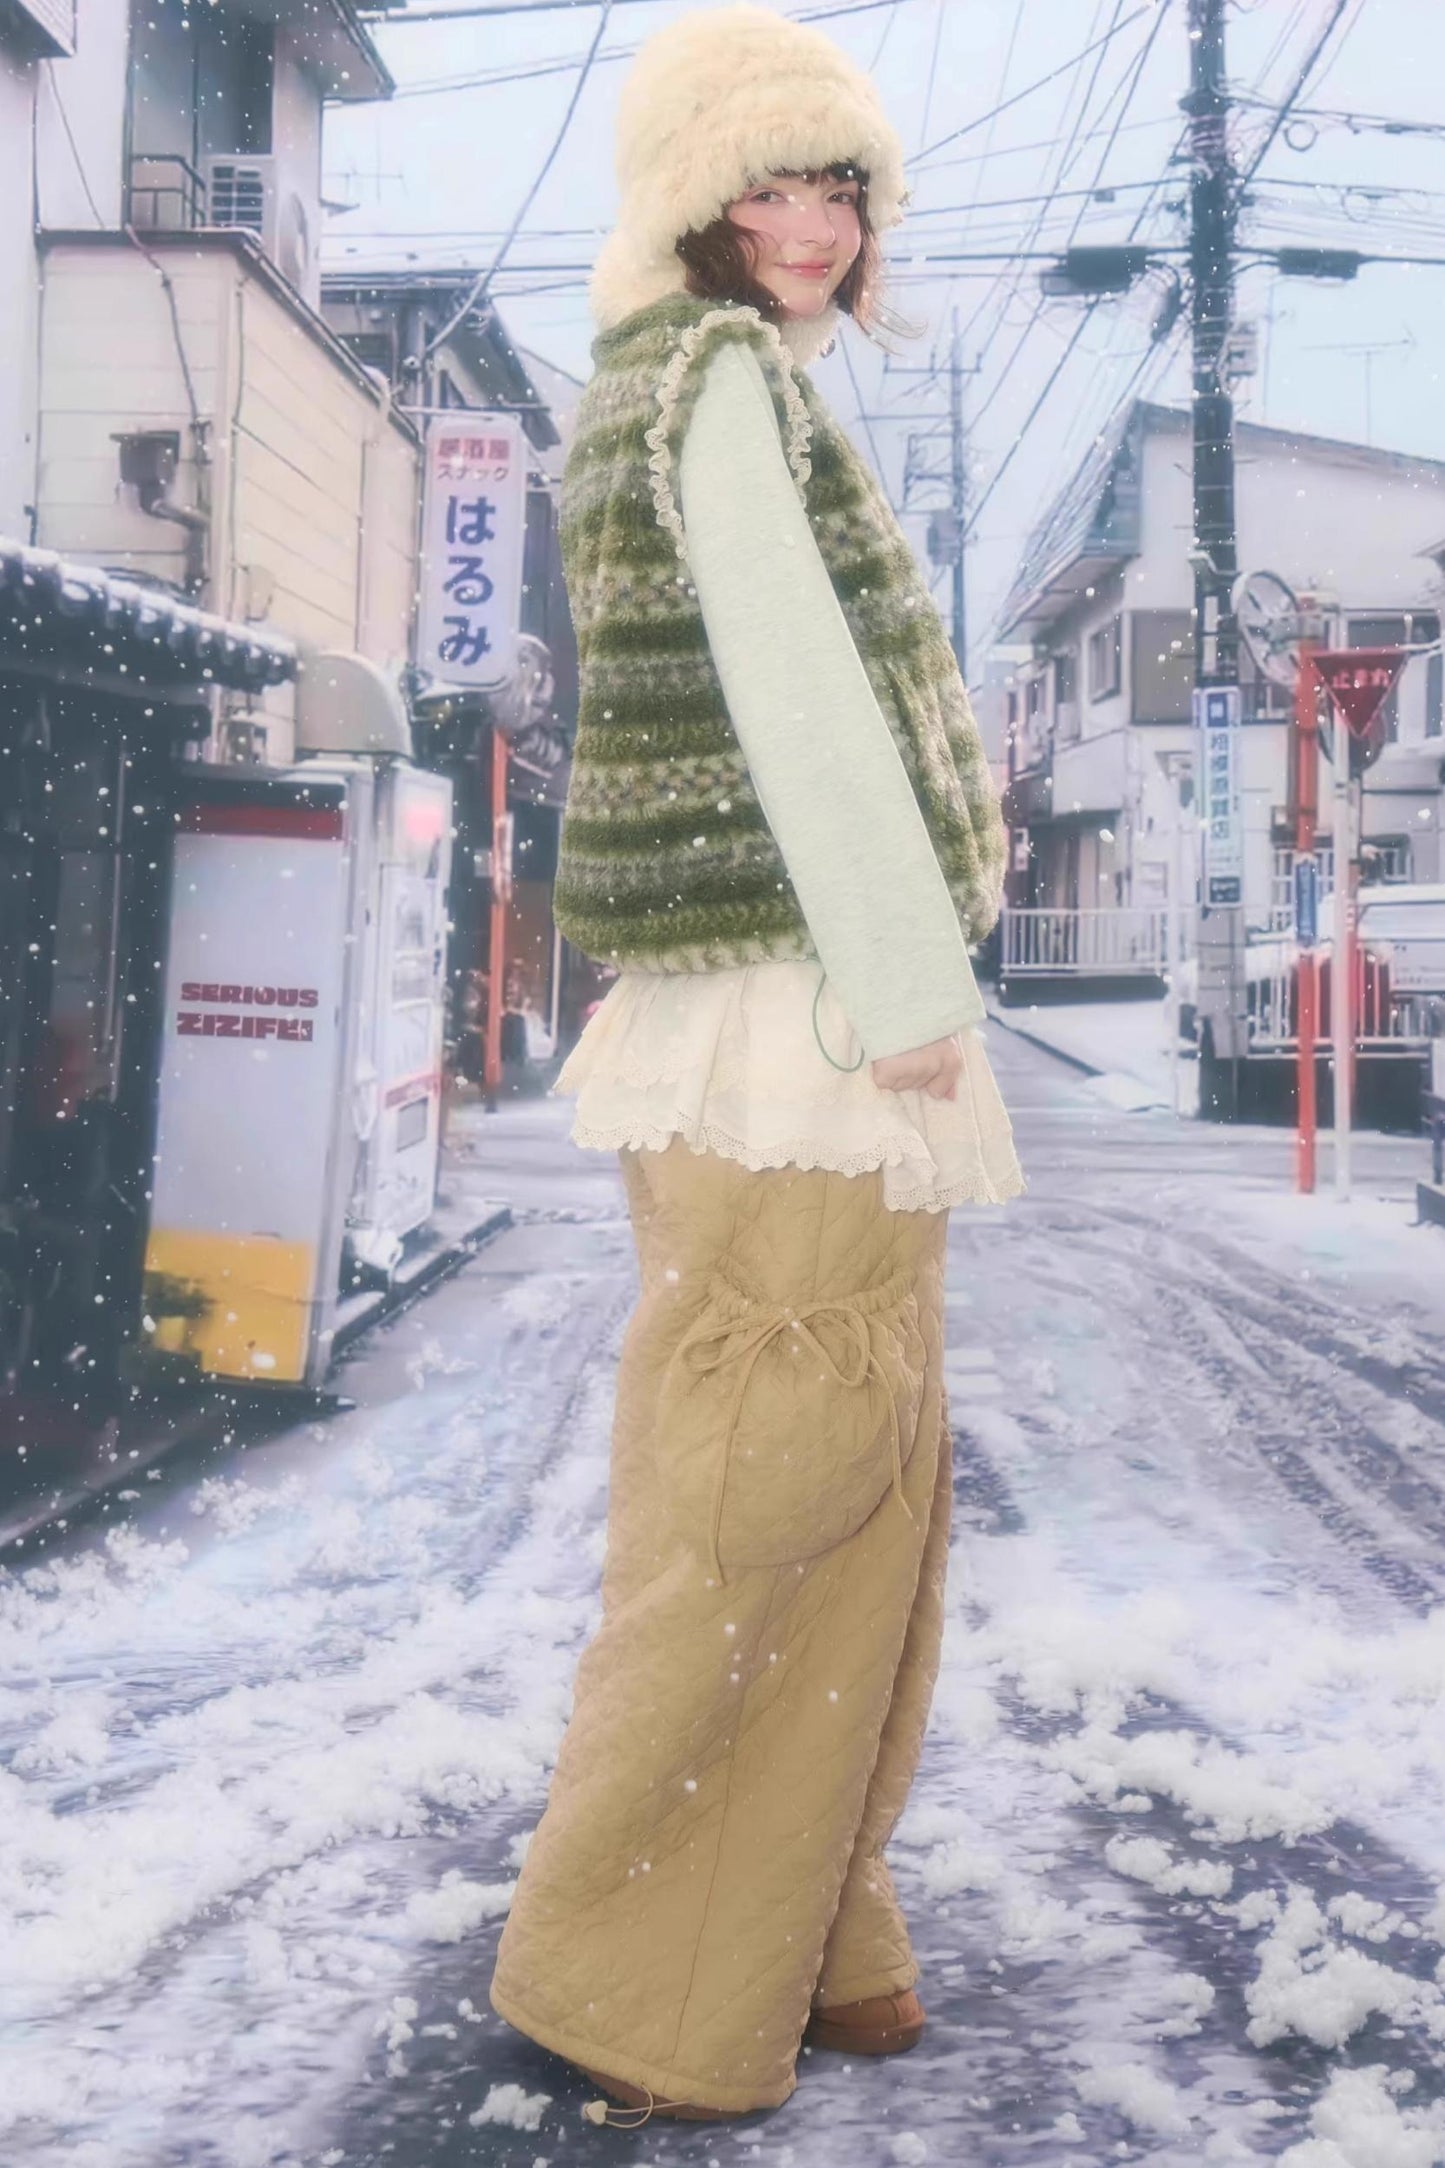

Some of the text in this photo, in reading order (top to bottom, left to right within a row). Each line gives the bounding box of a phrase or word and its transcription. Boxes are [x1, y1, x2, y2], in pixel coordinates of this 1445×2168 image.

[437, 464, 509, 481] スナック
[438, 495, 497, 667] はるみ
[181, 982, 318, 1008] SERIOUS
[177, 1012, 313, 1041] ZIZIFEI
